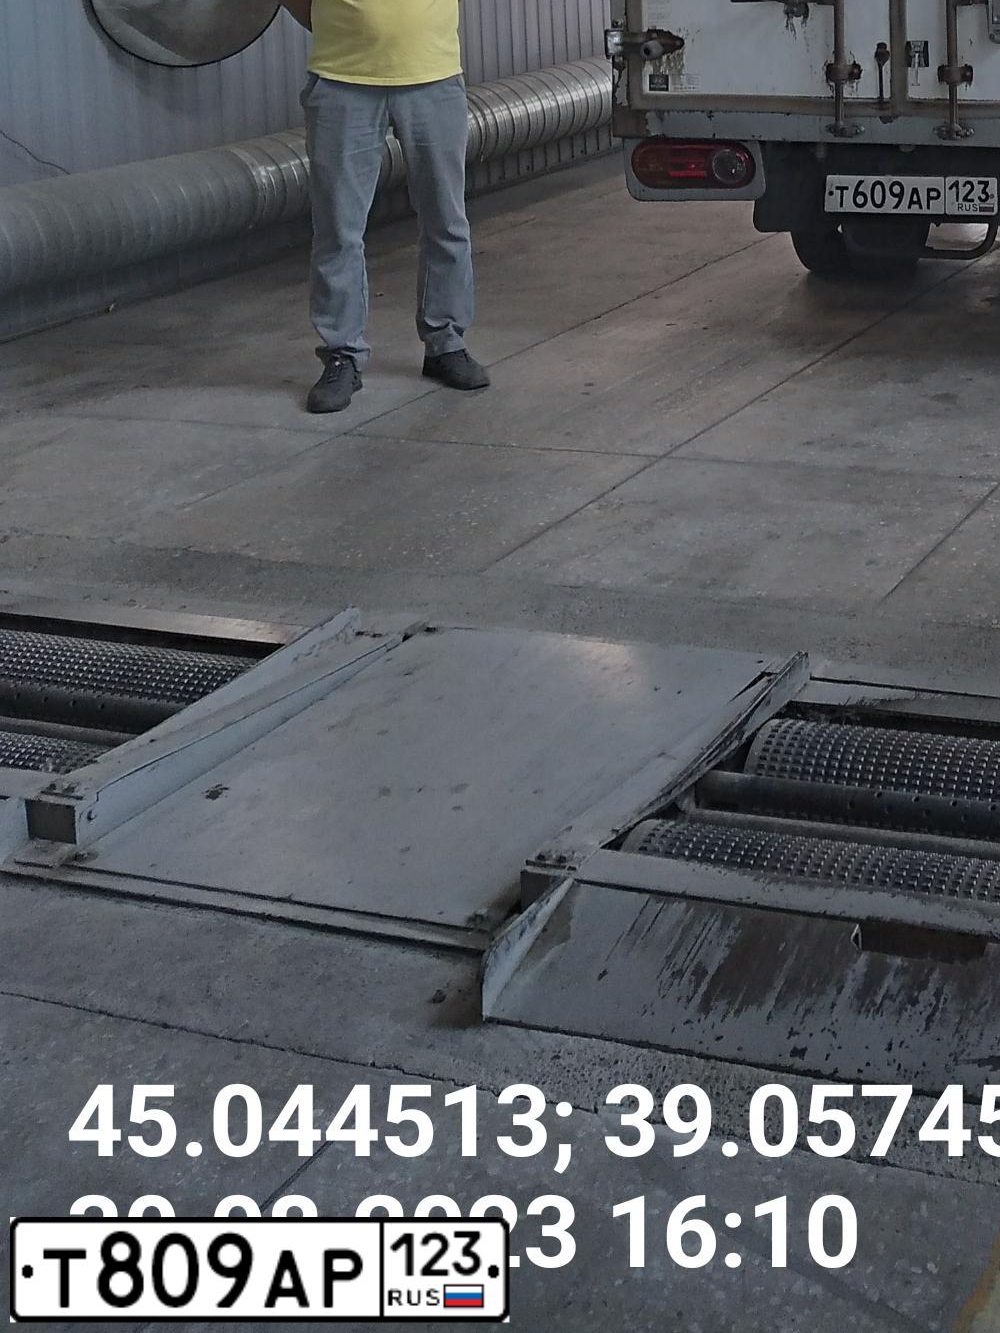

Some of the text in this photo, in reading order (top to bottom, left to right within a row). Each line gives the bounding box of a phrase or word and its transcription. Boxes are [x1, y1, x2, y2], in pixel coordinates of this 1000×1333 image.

[834, 179, 991, 210] Т609АР 123
[957, 203, 979, 213] RUS
